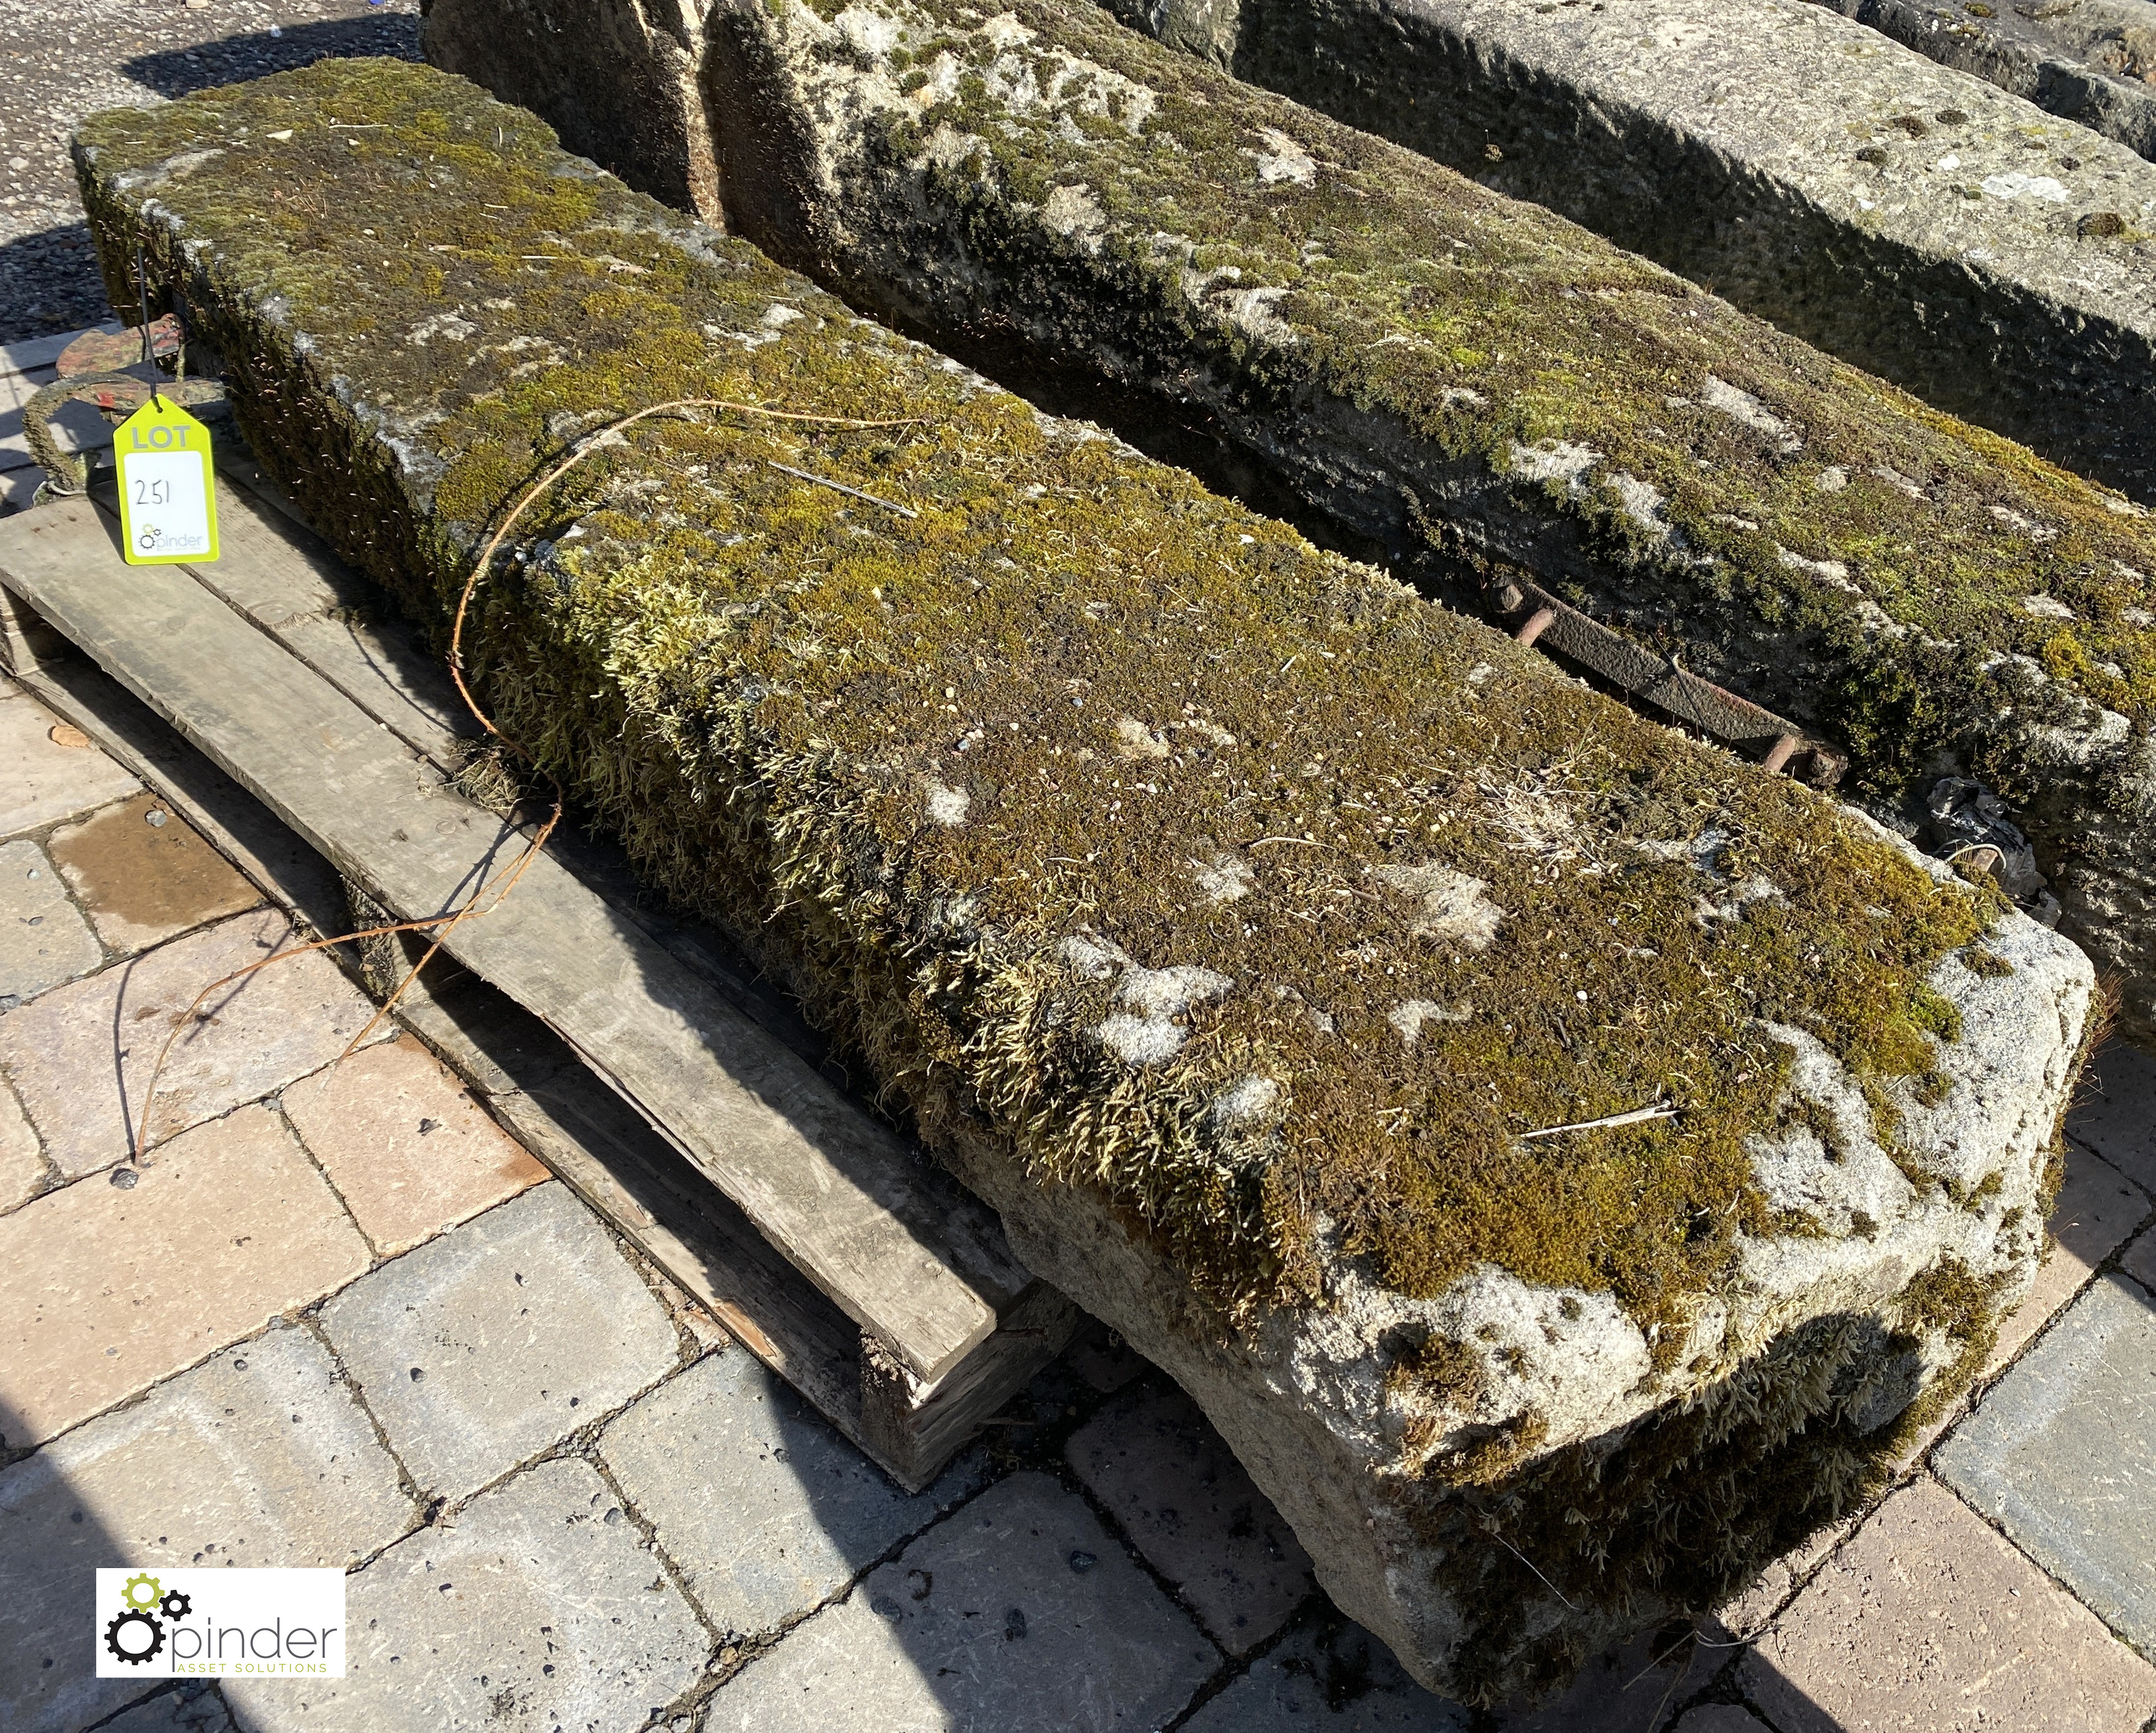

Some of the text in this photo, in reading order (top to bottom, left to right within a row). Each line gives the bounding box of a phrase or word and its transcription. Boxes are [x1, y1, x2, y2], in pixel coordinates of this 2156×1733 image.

[131, 425, 191, 449] LOT
[135, 479, 170, 505] 251
[156, 533, 202, 551] pinder
